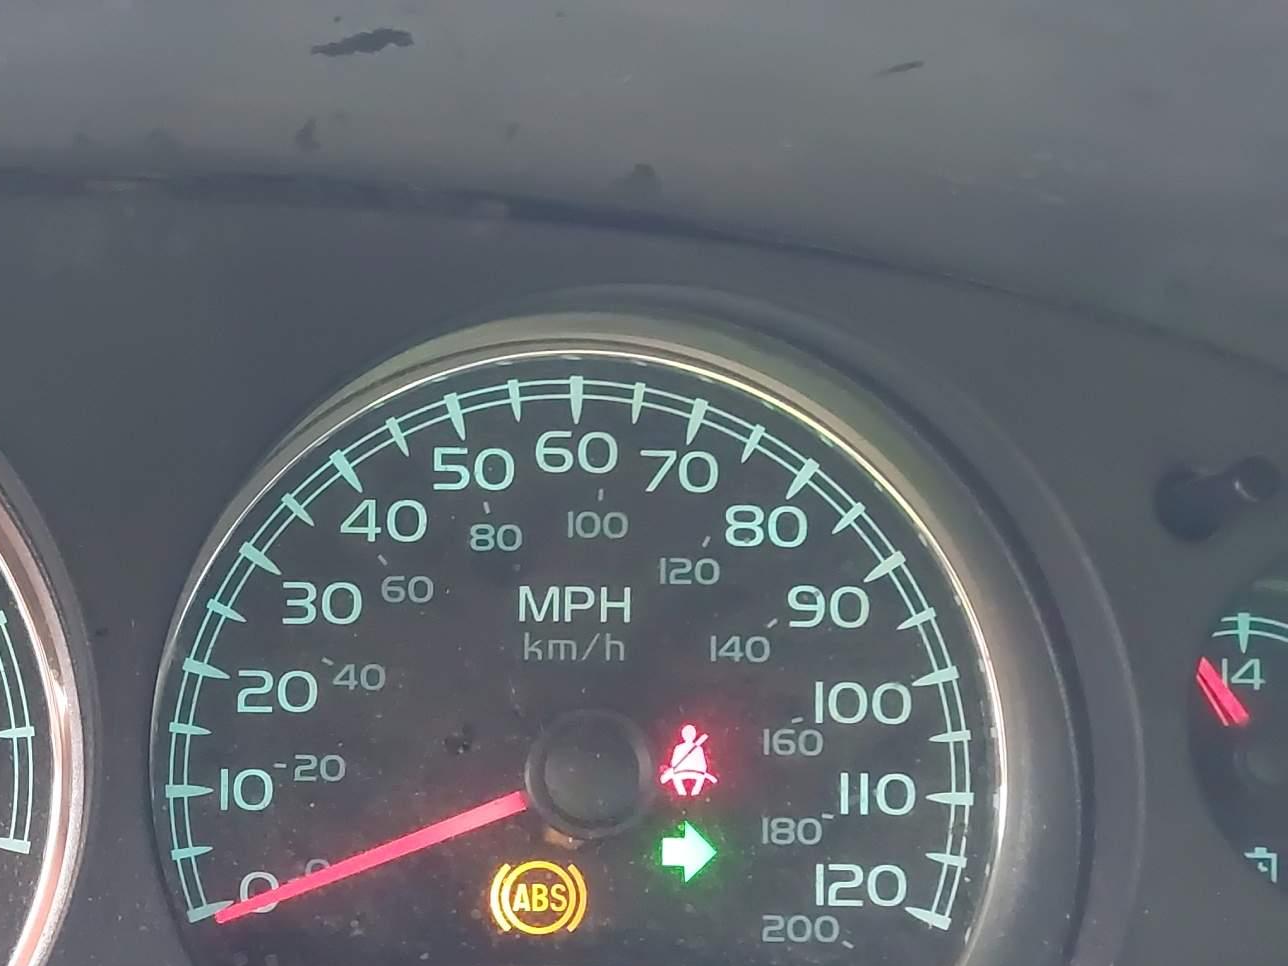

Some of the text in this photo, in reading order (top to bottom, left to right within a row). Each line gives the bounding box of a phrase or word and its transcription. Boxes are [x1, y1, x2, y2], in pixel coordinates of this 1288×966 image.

[433, 448, 514, 491] 50
[536, 431, 618, 474] 60
[640, 450, 718, 493] 70
[340, 500, 427, 543] 40
[470, 524, 522, 552] 80
[567, 511, 628, 539] 100
[725, 505, 807, 547] 80
[659, 558, 720, 585] 120
[282, 582, 361, 625] 30
[382, 576, 433, 603] 60
[518, 586, 630, 623] MPH
[788, 586, 869, 628] 90
[523, 633, 626, 661] km/h
[710, 636, 770, 663] 140
[333, 664, 386, 691] 40
[1222, 658, 1266, 690] 14
[237, 670, 317, 713] 20
[815, 682, 911, 724] 100
[763, 729, 823, 757] 160
[294, 755, 345, 782] 20
[220, 768, 273, 811] 10
[840, 773, 915, 816] 110
[762, 818, 822, 845] 180
[513, 883, 567, 912] ABS
[815, 864, 907, 906] 120
[762, 915, 839, 943] 200
